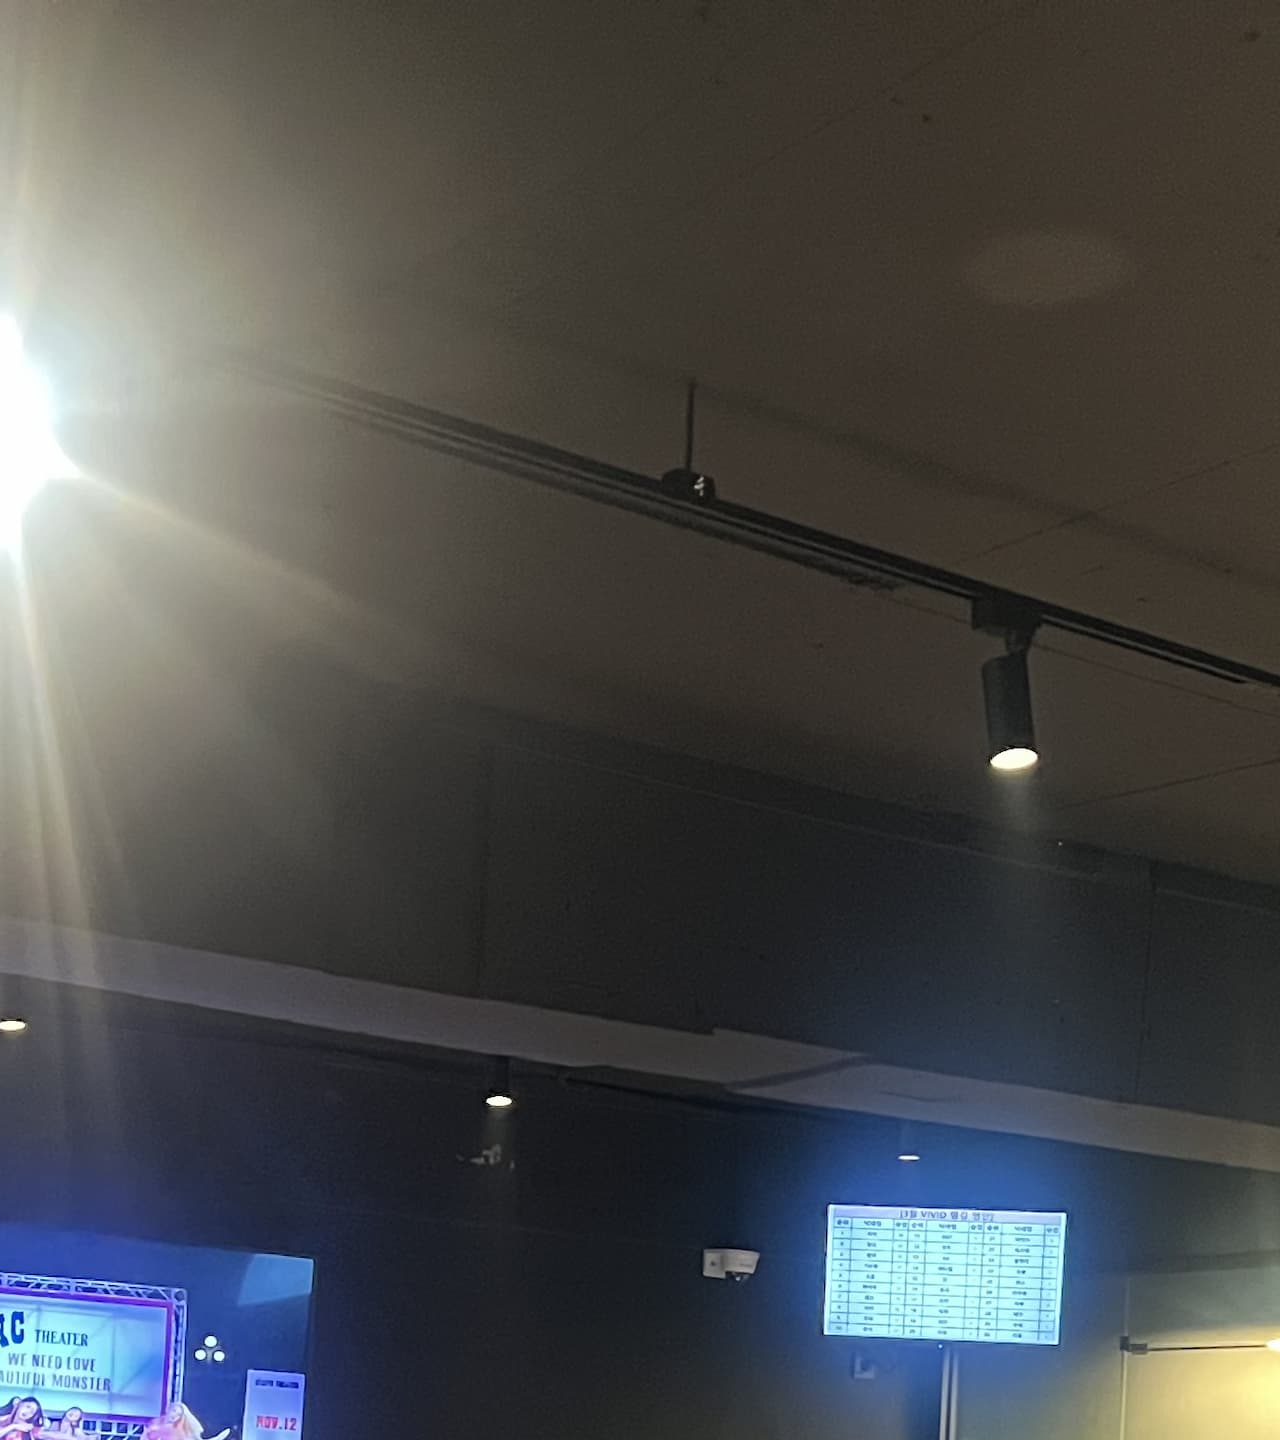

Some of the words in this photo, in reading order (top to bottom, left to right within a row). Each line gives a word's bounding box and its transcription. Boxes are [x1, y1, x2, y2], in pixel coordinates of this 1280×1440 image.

[920, 1210, 947, 1220] VIVID
[34, 1329, 89, 1347] THEATER
[8, 1352, 26, 1367] WE
[32, 1354, 62, 1370] NEED
[67, 1355, 97, 1373] LOVE
[52, 1373, 112, 1392] MONSTER
